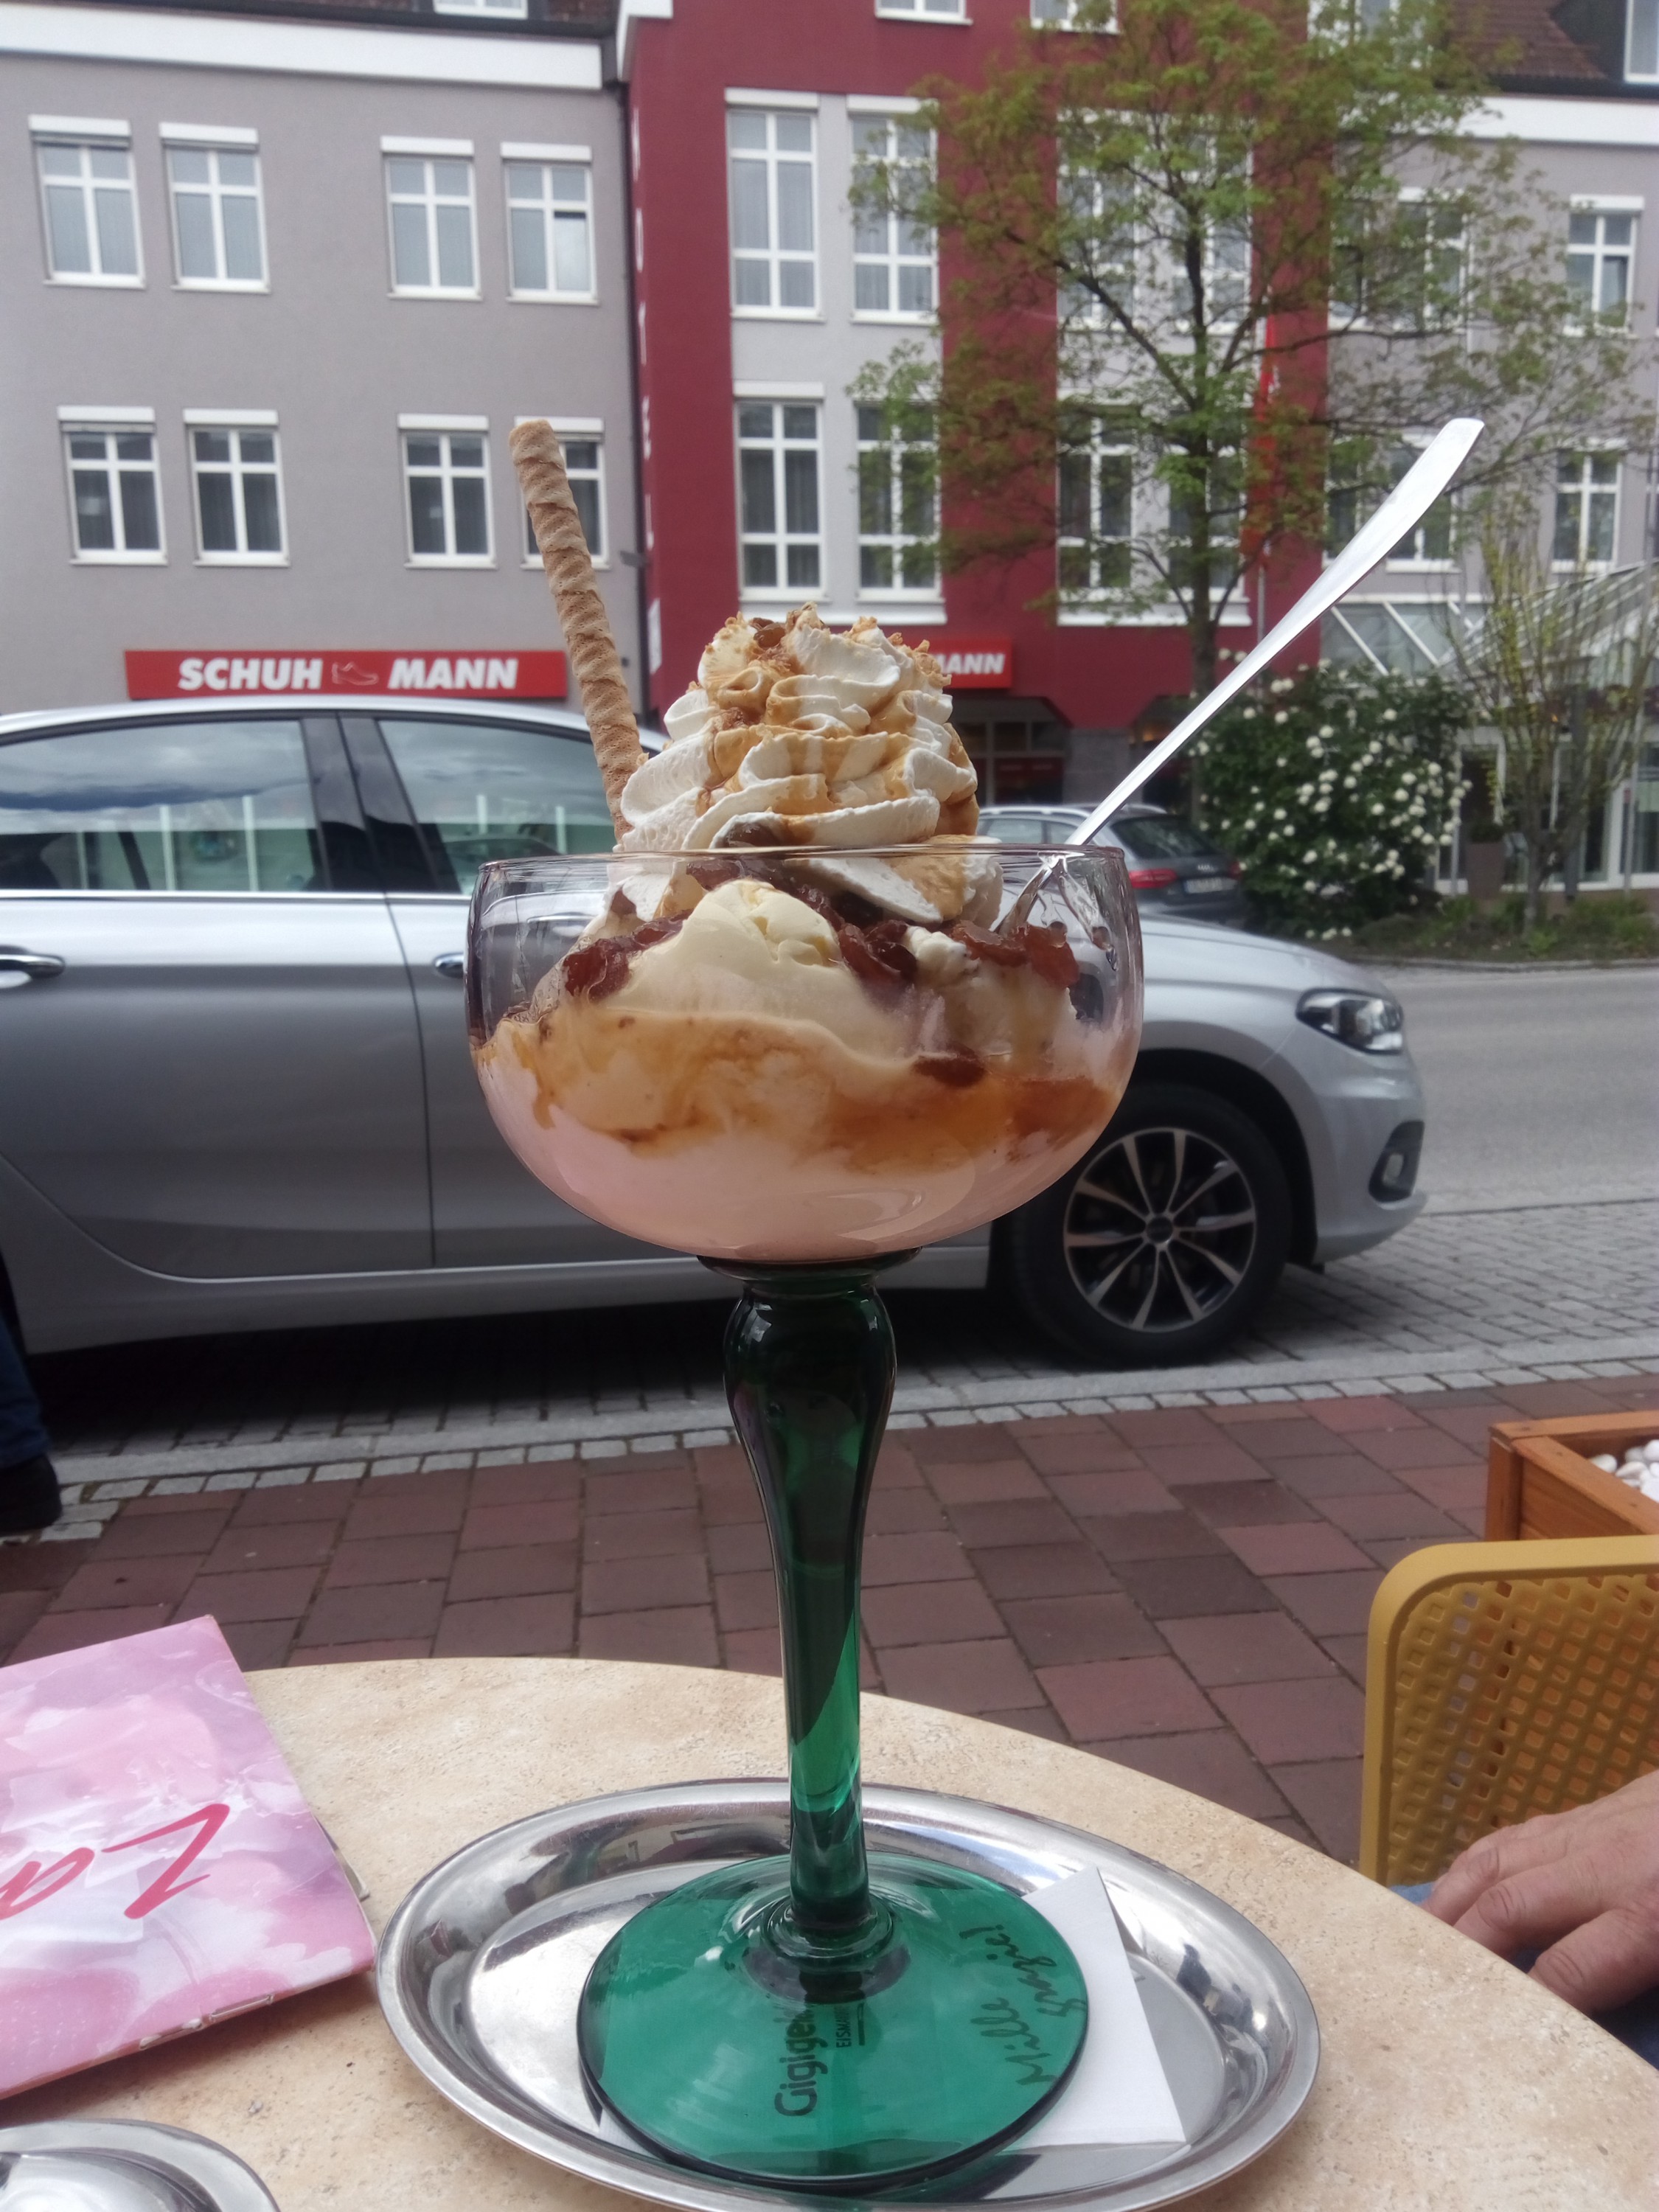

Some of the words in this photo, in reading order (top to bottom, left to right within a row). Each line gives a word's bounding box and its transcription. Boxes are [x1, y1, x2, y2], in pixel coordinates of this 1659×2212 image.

[177, 658, 323, 690] SCHUH
[388, 658, 518, 689] MANN
[970, 1997, 1056, 2085] Mille
